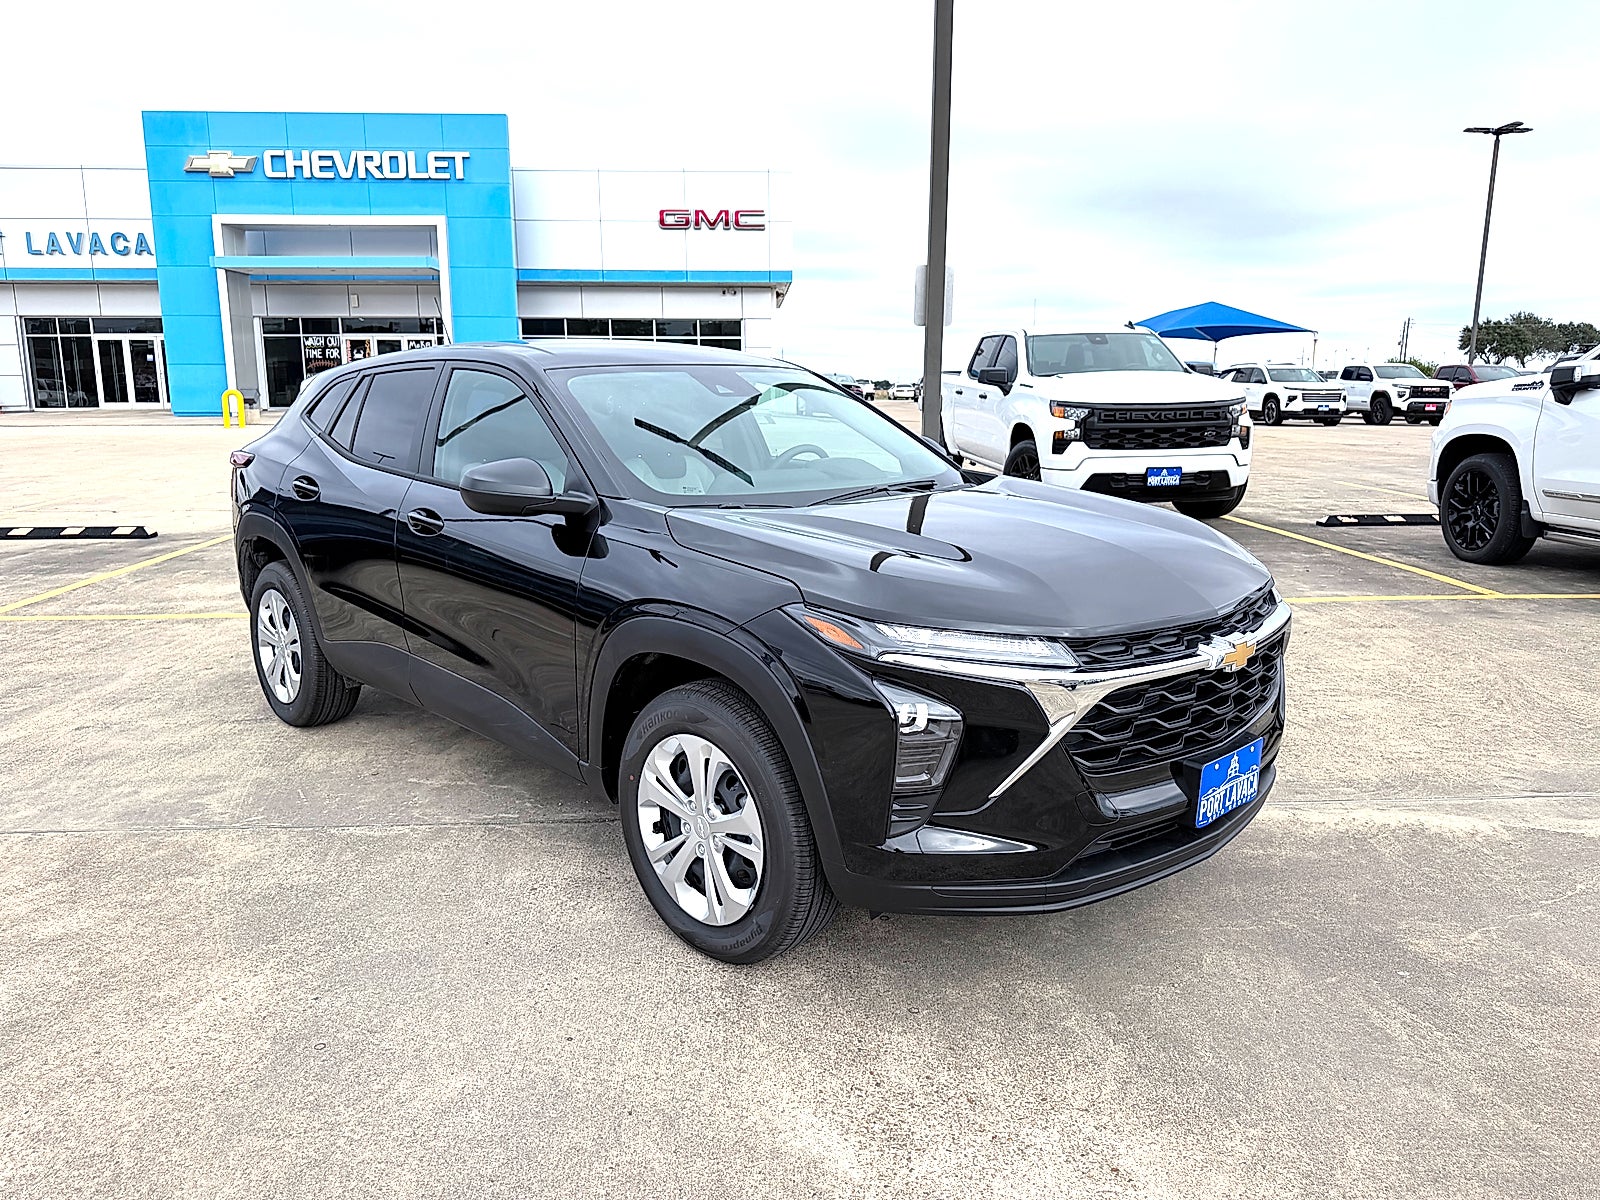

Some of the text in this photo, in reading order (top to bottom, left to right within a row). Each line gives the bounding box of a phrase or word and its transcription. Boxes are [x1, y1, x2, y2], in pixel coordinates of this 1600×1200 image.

[263, 149, 470, 180] CHEVROLET
[659, 209, 765, 230] GMC
[25, 231, 154, 256] LAVACA
[304, 336, 340, 347] WATCH OUT
[305, 348, 323, 358] TIME
[325, 348, 341, 359] FOR
[1100, 410, 1227, 421] CHEVROLET
[1199, 772, 1259, 821] PORT LAVACA
